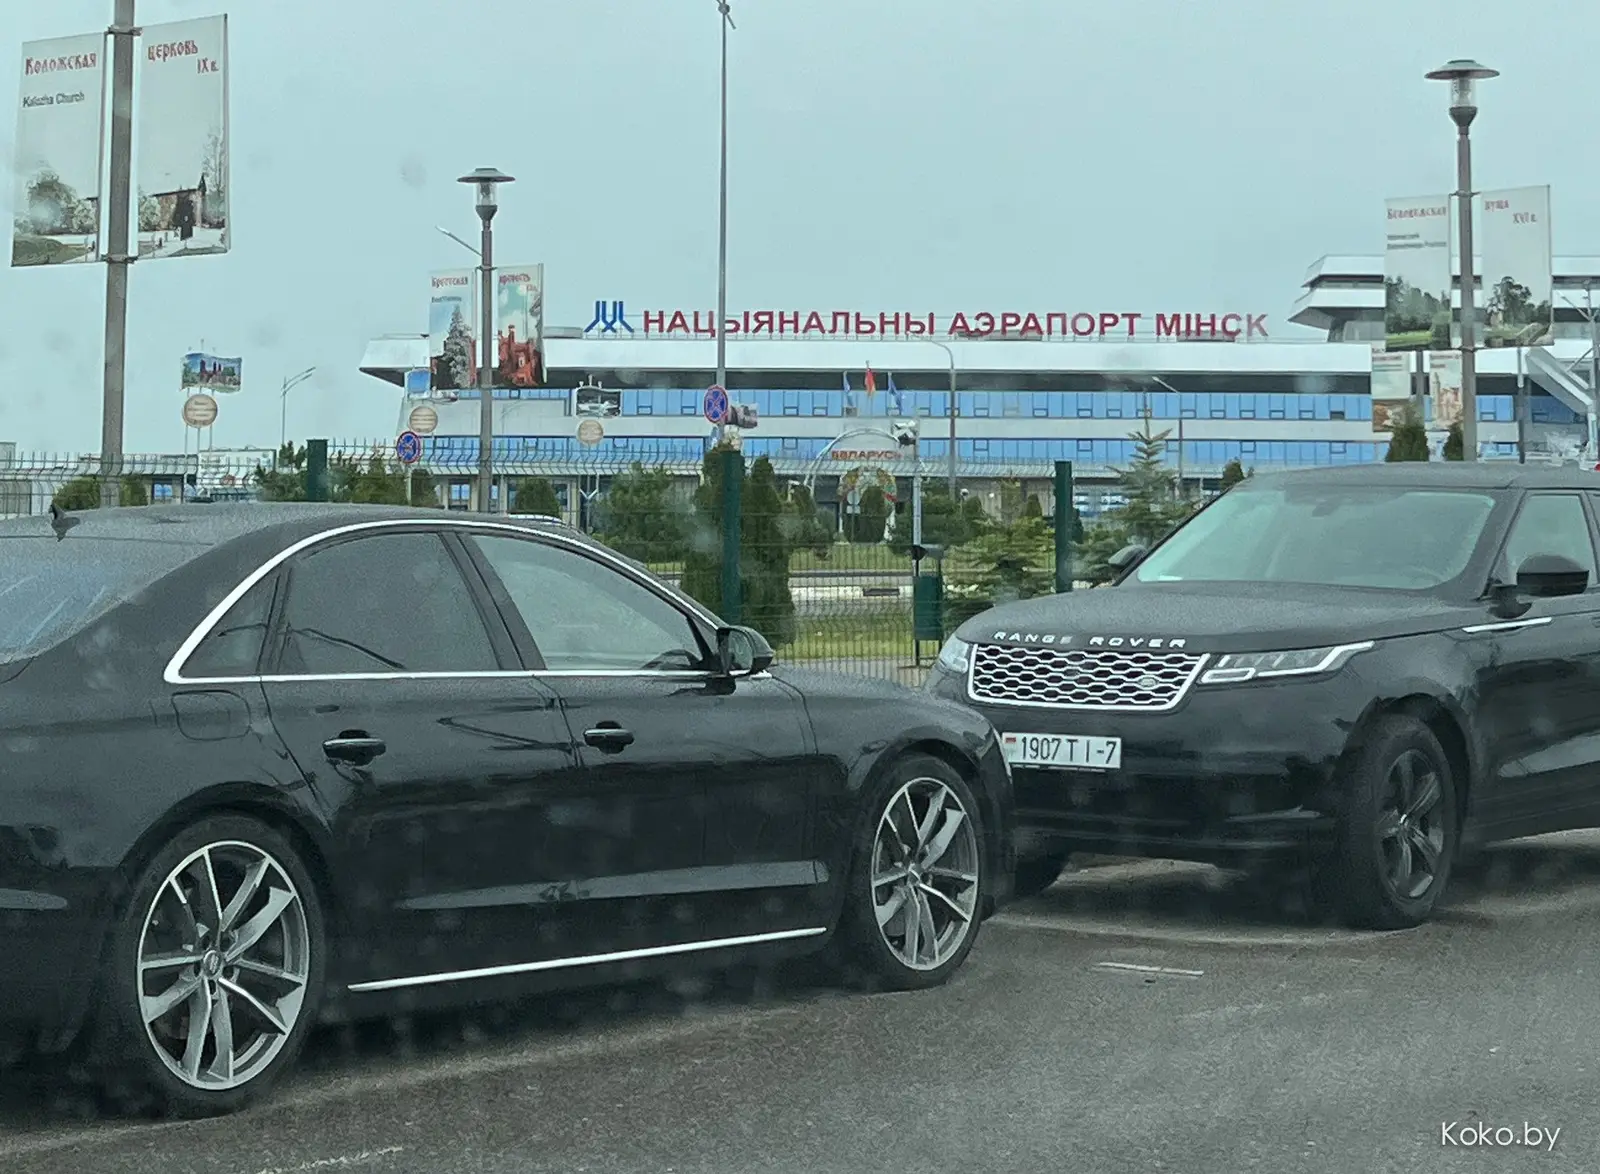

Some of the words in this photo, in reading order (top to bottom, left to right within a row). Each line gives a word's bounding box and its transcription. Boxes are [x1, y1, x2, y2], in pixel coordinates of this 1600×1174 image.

[56, 92, 85, 104] Church
[643, 310, 934, 338] НАЦЫЯНАЛЬНЫ
[949, 312, 1142, 337] АЭРАПОРТ
[994, 631, 1073, 645] RANGE
[1089, 636, 1186, 649] ROVER
[1021, 736, 1062, 760] 1907
